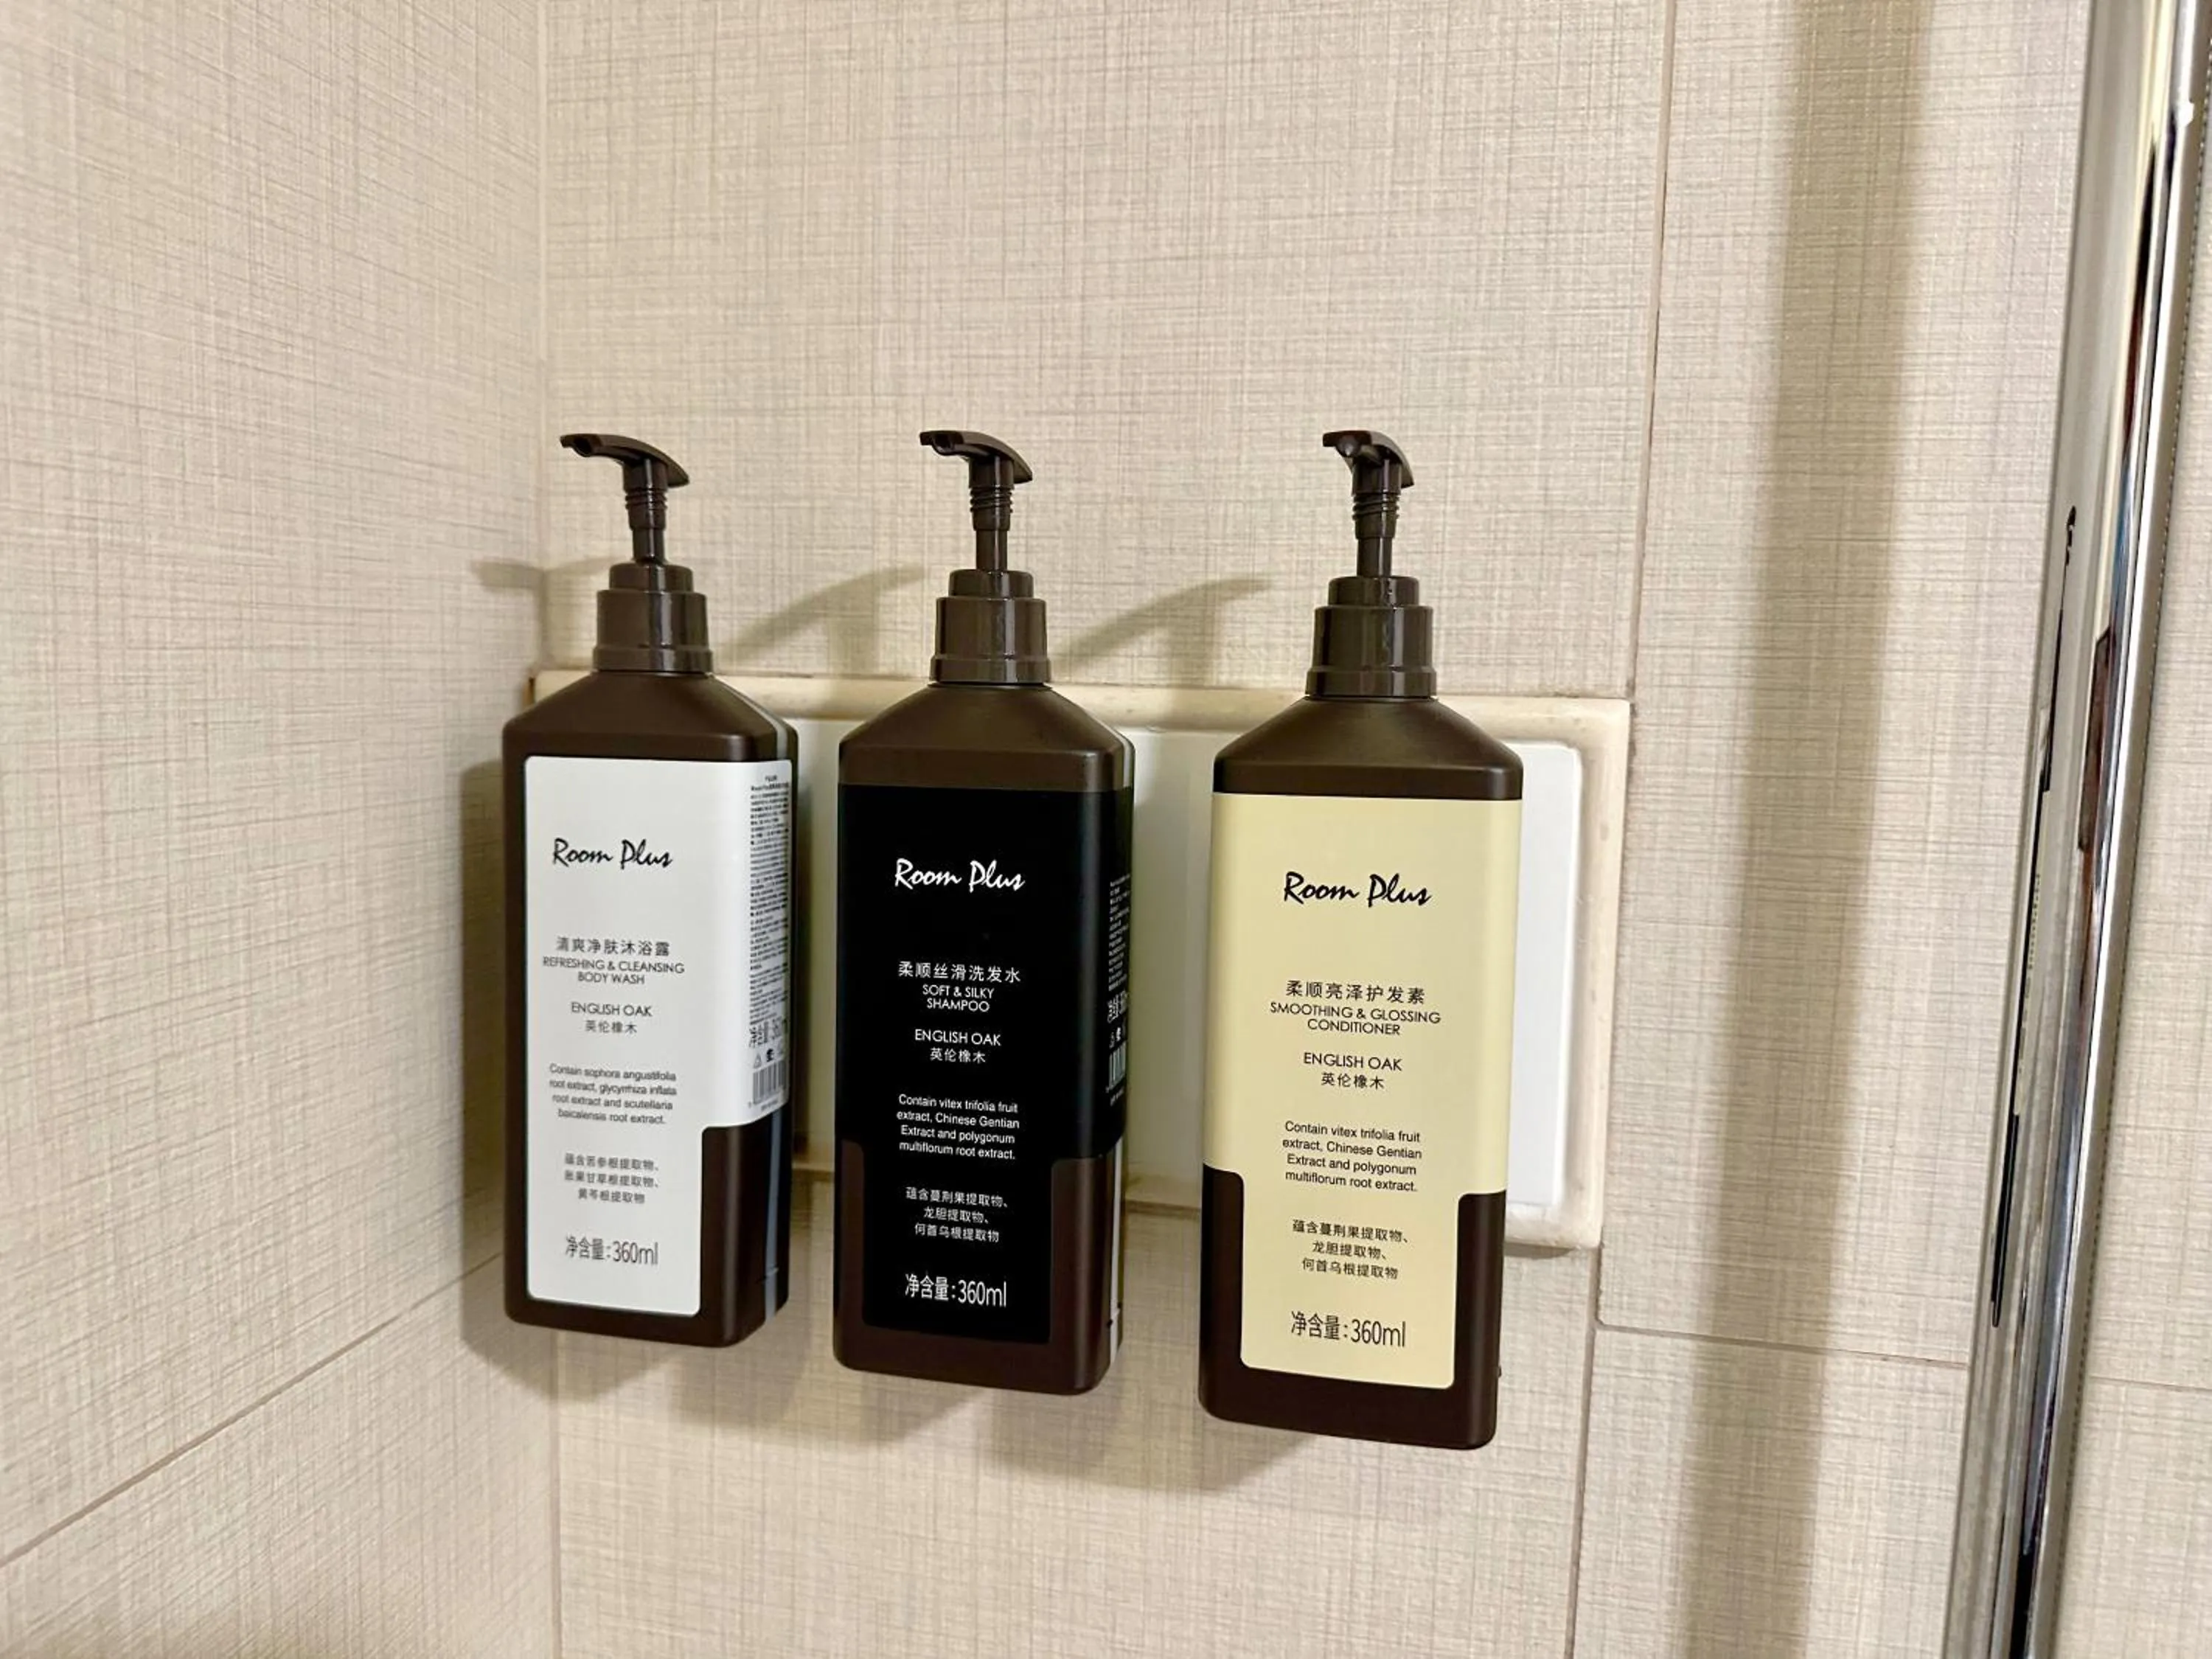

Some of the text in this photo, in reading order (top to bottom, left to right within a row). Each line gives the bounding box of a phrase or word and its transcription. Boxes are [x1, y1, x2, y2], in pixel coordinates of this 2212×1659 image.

[553, 838, 673, 870] Room Plus
[894, 858, 1025, 893] Room Plus
[1283, 871, 1433, 908] Room Plus
[556, 936, 670, 957] 清爽净肤沐浴露
[543, 956, 685, 974] REFRESHING & CLEANSING
[898, 961, 1021, 984] 柔顺丝滑洗发水
[578, 972, 644, 984] BODY WASH
[922, 984, 995, 999] SOFT & SILKY
[1285, 979, 1425, 1006] 柔顺亮泽护发素
[571, 1001, 653, 1017] ENGLISH OAK
[927, 998, 990, 1012] SHAMPOO
[1270, 1002, 1441, 1024] SMOOTHING & GLOSSING
[585, 1020, 637, 1034] 英伦橡木
[1307, 1018, 1401, 1035] CONDITIONER
[914, 1029, 1001, 1046] ENGLISH OAK
[930, 1047, 986, 1064] 英伦橡木
[1303, 1052, 1402, 1071] ENGLISH OAK
[549, 1062, 582, 1075] Contain
[584, 1068, 620, 1079] sophora
[549, 1079, 565, 1088] root
[1321, 1072, 1385, 1091] 英伦橡木
[552, 1094, 673, 1110] root extract and scutellaria
[898, 1093, 1018, 1113] Contain vitex trifolia fruit
[557, 1108, 667, 1124] baicalensis root extract.
[897, 1110, 1020, 1129] extract, Chinese Gentian
[900, 1124, 1015, 1145] Extract and polygonum
[1284, 1120, 1421, 1143] Contain vitex trifolia fruit
[899, 1141, 1016, 1160] multiflorum root extract.
[1282, 1138, 1422, 1160] extract, Chinese Gentian
[1287, 1154, 1417, 1177] Extract and polygonum
[1285, 1171, 1419, 1192] multiflorum root extract.
[1302, 1257, 1399, 1279] 何首乌根提取物
